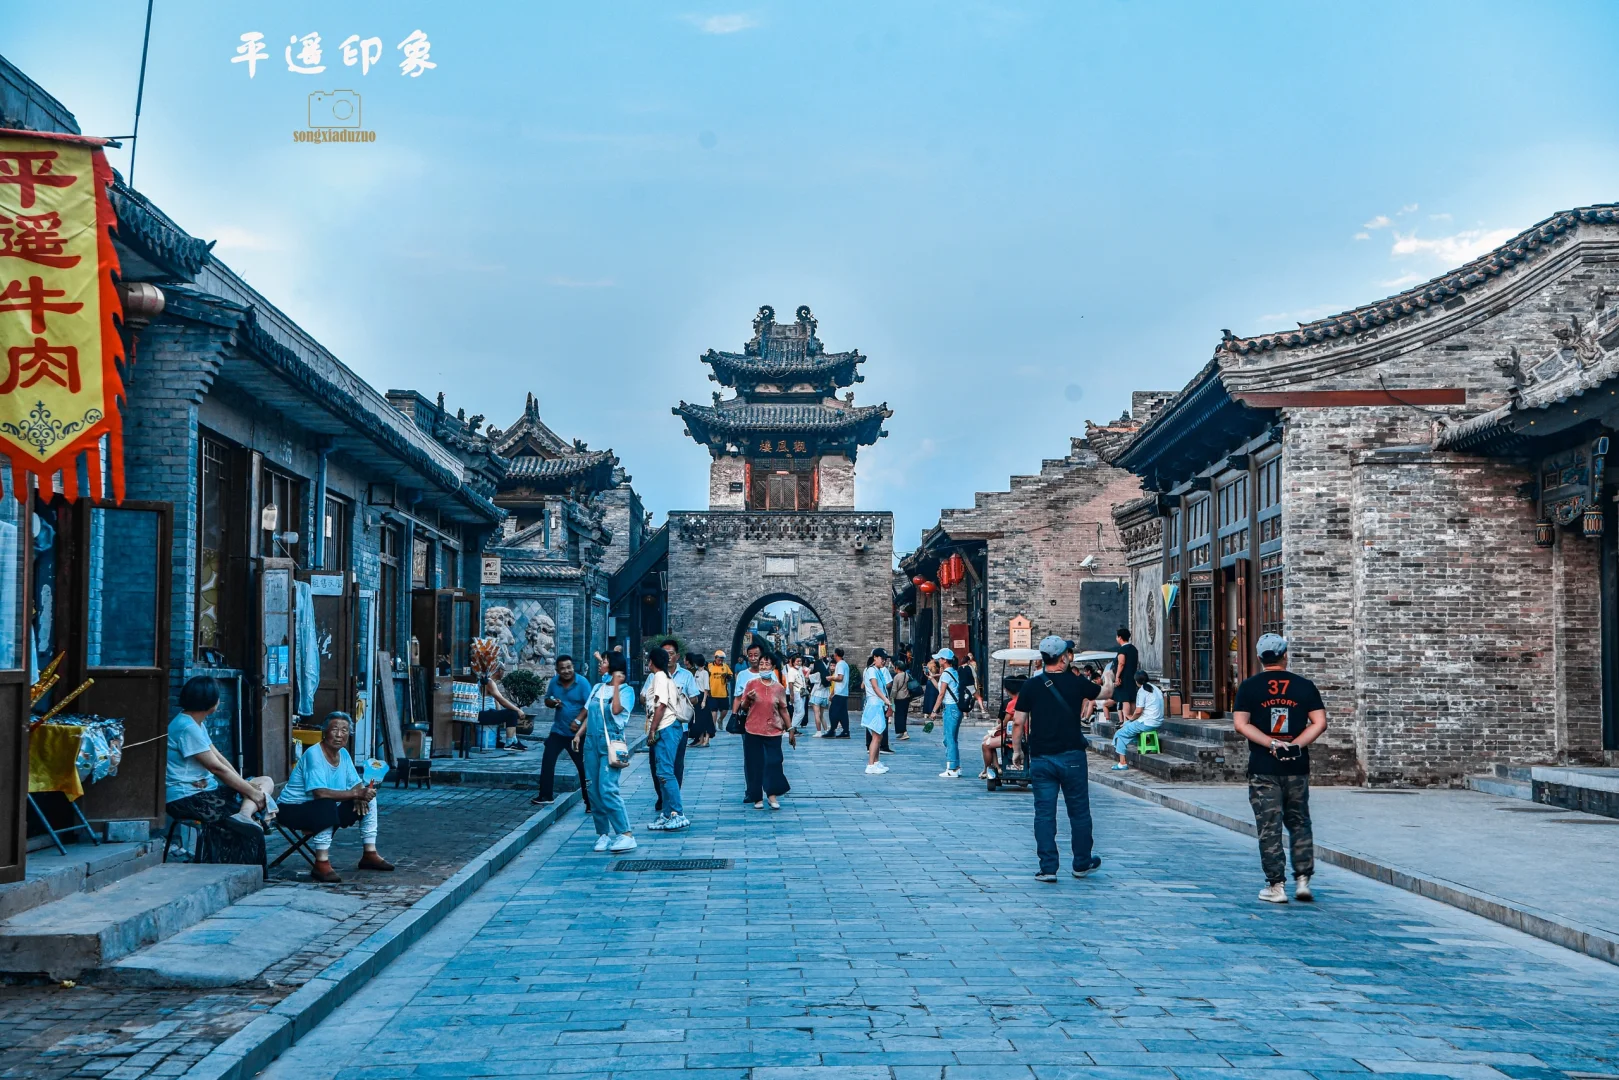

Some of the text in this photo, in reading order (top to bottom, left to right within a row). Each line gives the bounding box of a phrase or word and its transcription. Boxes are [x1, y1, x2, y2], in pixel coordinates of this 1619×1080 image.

[0, 150, 84, 394] 平遥牛肉
[1268, 680, 1290, 695] 37
[1261, 698, 1298, 708] VICTORY
